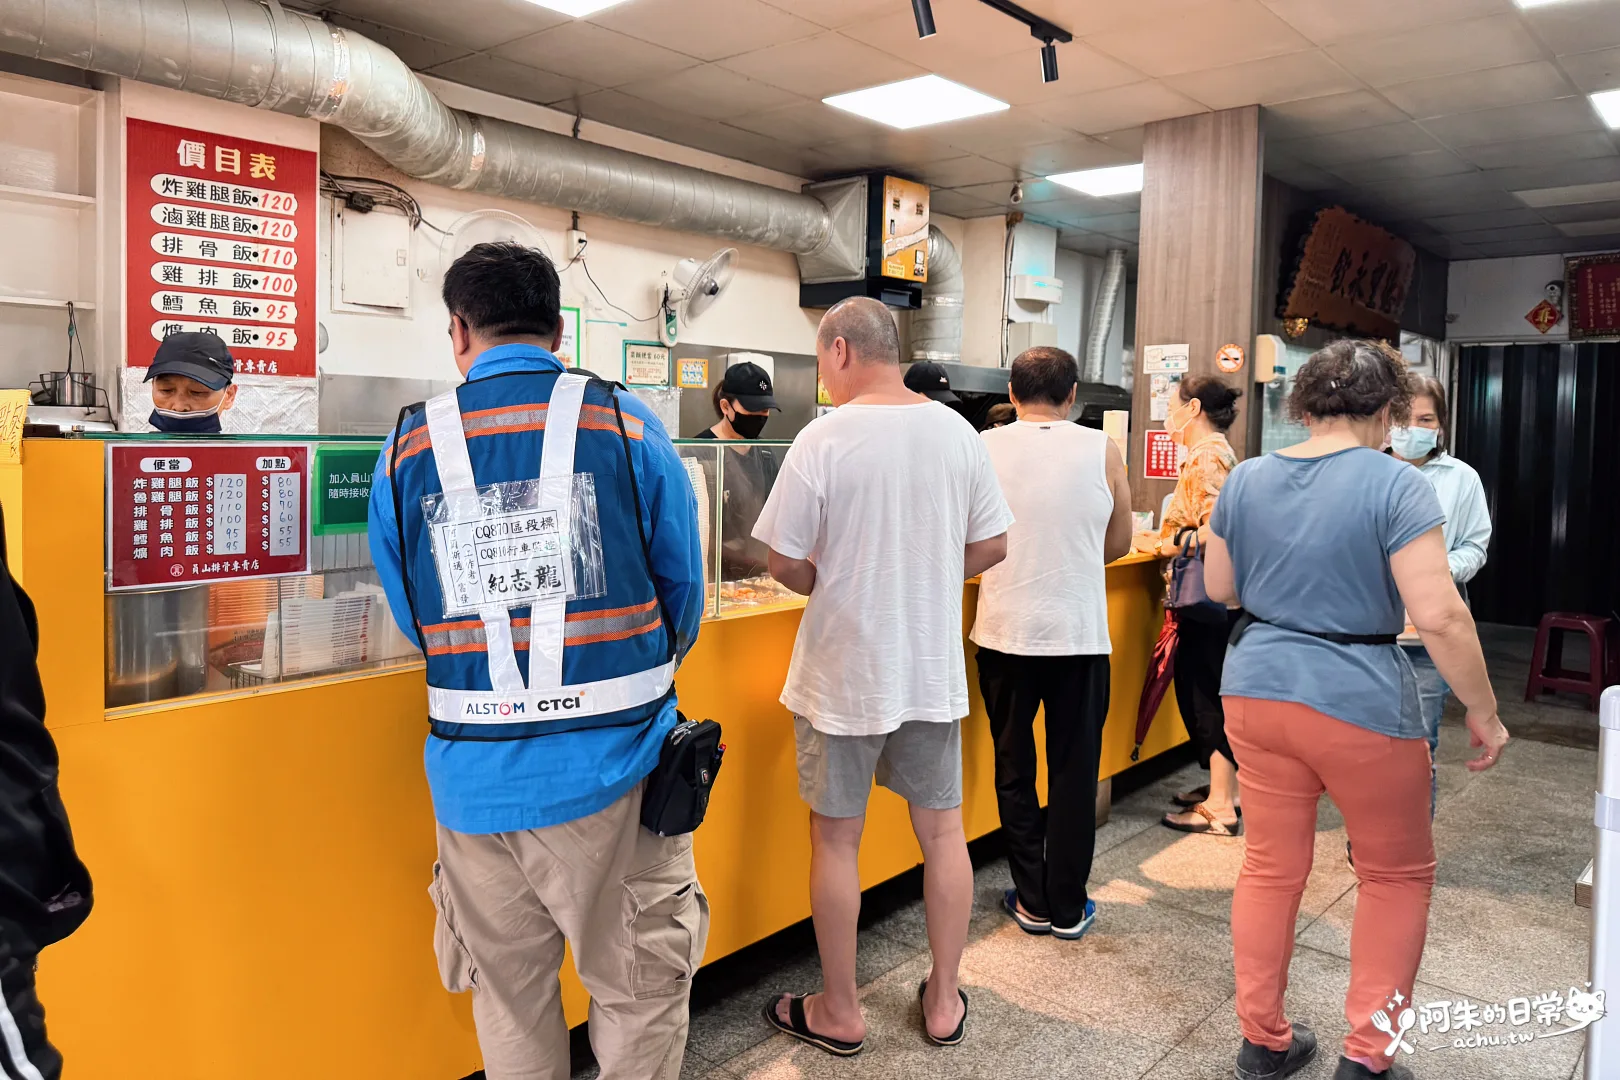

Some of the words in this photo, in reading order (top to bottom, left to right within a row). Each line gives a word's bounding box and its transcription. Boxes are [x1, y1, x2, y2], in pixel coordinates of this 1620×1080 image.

[177, 139, 276, 181] 價目表
[162, 177, 251, 206] 炸雞腿飯
[260, 193, 292, 212] 120
[162, 206, 251, 234] 滷雞腿飯
[260, 220, 292, 238] 120
[162, 236, 251, 262] 排骨飯
[261, 249, 293, 266] 110
[162, 265, 251, 290] 雞排飯
[261, 276, 293, 293] 100
[162, 294, 251, 317] 鱈魚飯
[265, 303, 288, 320] 95
[265, 331, 288, 347] 95
[153, 459, 180, 471] 便當
[262, 458, 286, 469] 加點
[133, 477, 199, 489] 炸雞腿飯
[329, 473, 373, 484] 加入員山
[133, 491, 199, 503] 魯雞腿飯
[328, 488, 372, 499] 隨時接收
[133, 504, 199, 517] 排骨飯
[133, 518, 199, 532] 雞排飯
[133, 531, 199, 545] 鱈魚飯
[192, 559, 260, 575] 員山排骨專賣店
[488, 564, 562, 594] 紀志龍
[466, 702, 525, 715] ALSTOM
[537, 697, 581, 711] CTCI
